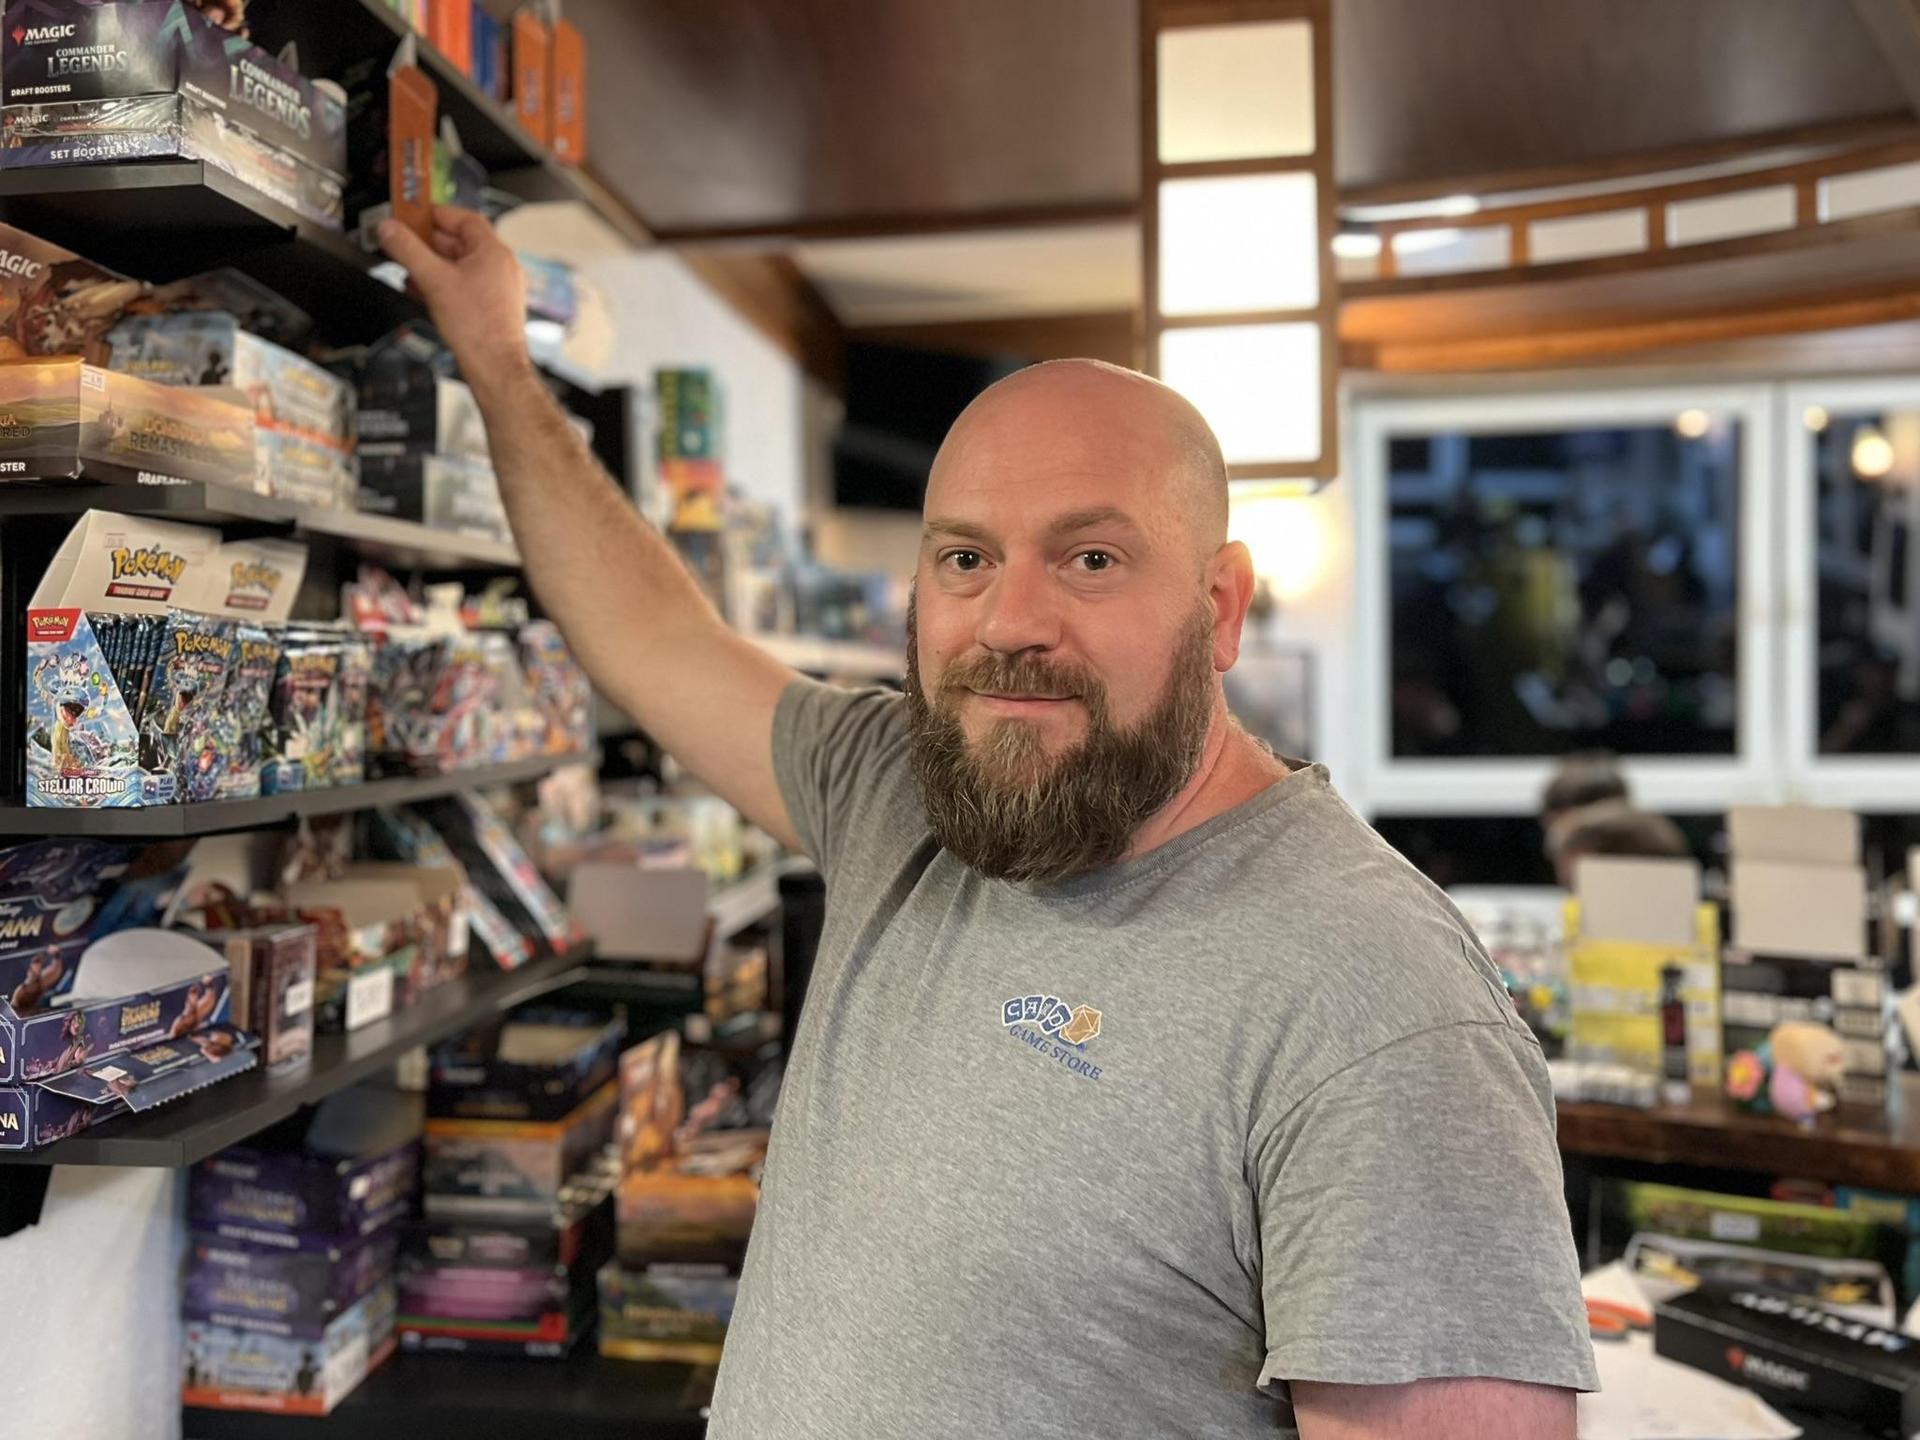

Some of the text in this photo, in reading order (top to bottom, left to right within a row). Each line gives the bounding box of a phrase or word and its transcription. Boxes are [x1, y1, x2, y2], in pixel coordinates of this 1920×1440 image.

[25, 24, 76, 41] MAGIC
[56, 44, 116, 57] COMMANDER
[47, 50, 128, 78] LEGENDS
[11, 84, 71, 97] DRAFT BOOSTERS
[229, 64, 312, 141] LEGENDS
[50, 149, 70, 160] SET
[38, 776, 126, 796] STELLAR CROWN
[1009, 1024, 1103, 1081] GAME STORE
